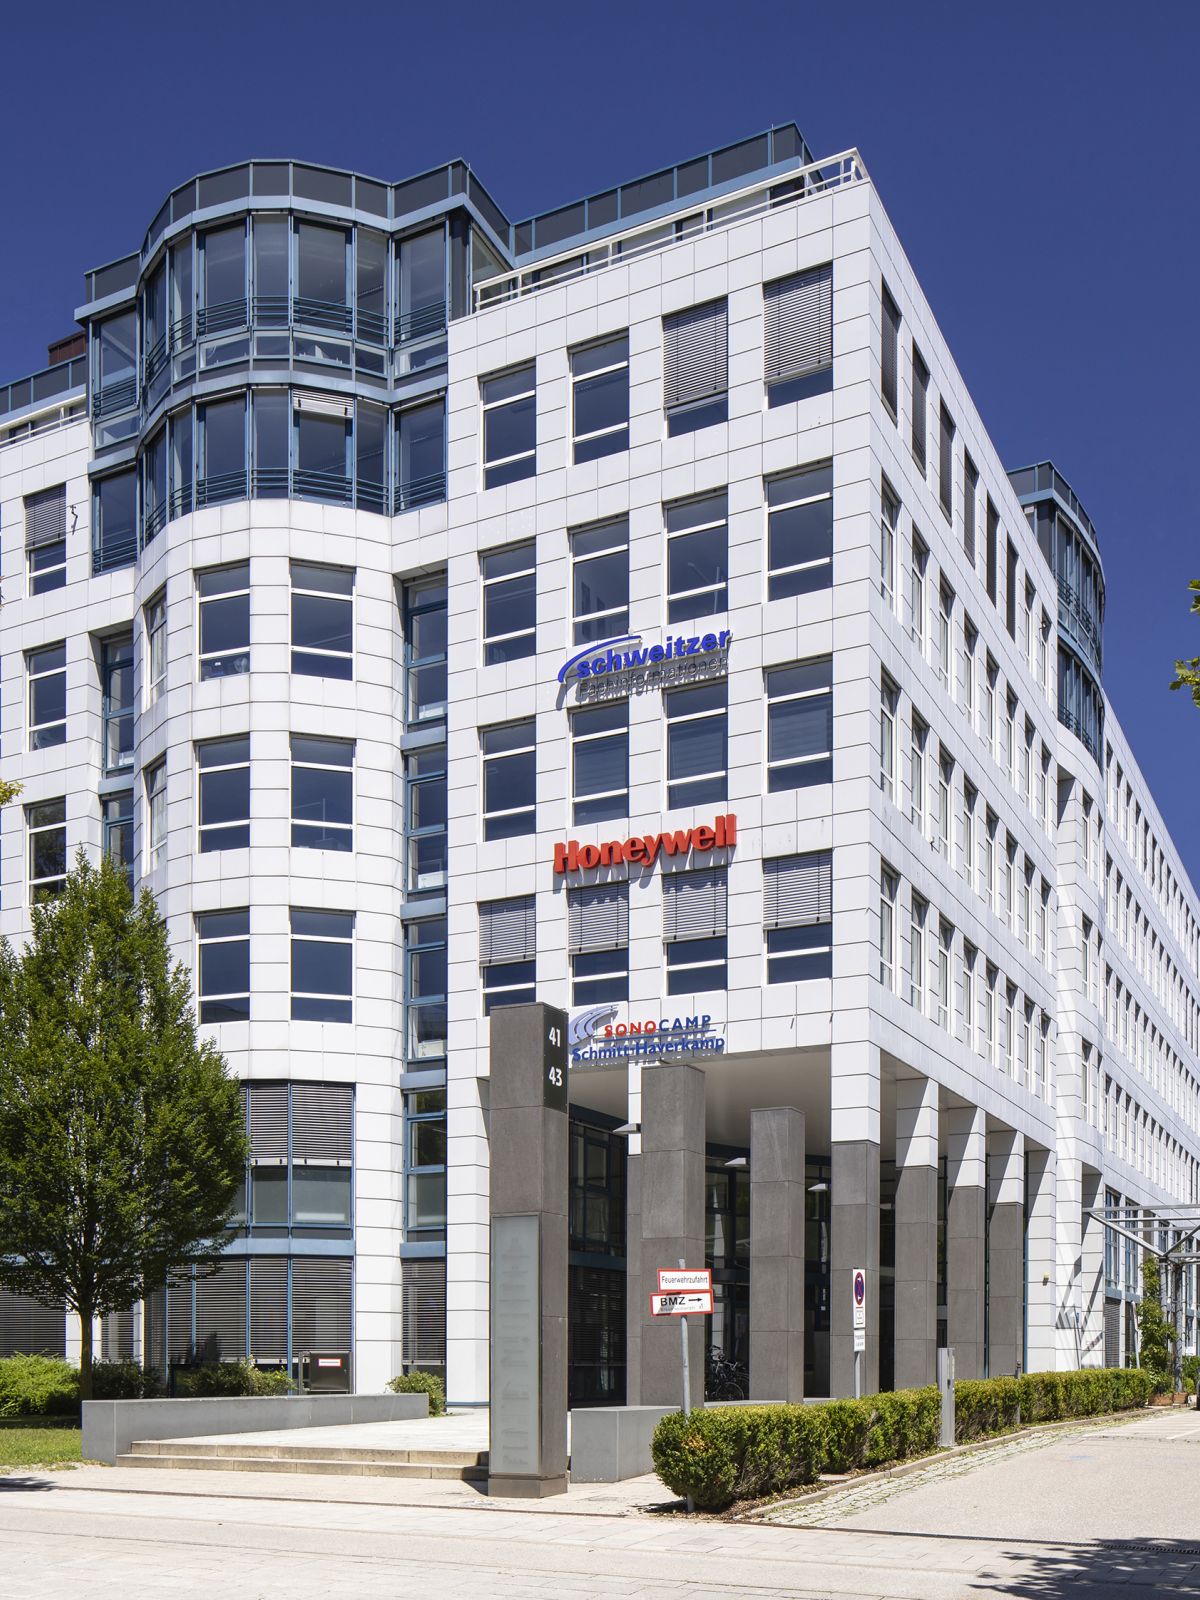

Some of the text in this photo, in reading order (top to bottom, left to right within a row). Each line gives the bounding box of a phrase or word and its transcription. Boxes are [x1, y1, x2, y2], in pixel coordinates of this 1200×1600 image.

[576, 629, 731, 679] schweitzer
[553, 813, 738, 875] Honeywell
[548, 1026, 561, 1048] 41
[548, 1066, 563, 1087] 43
[661, 1275, 708, 1284] Feuerwehrzufahrt
[660, 1296, 686, 1307] BMZ
